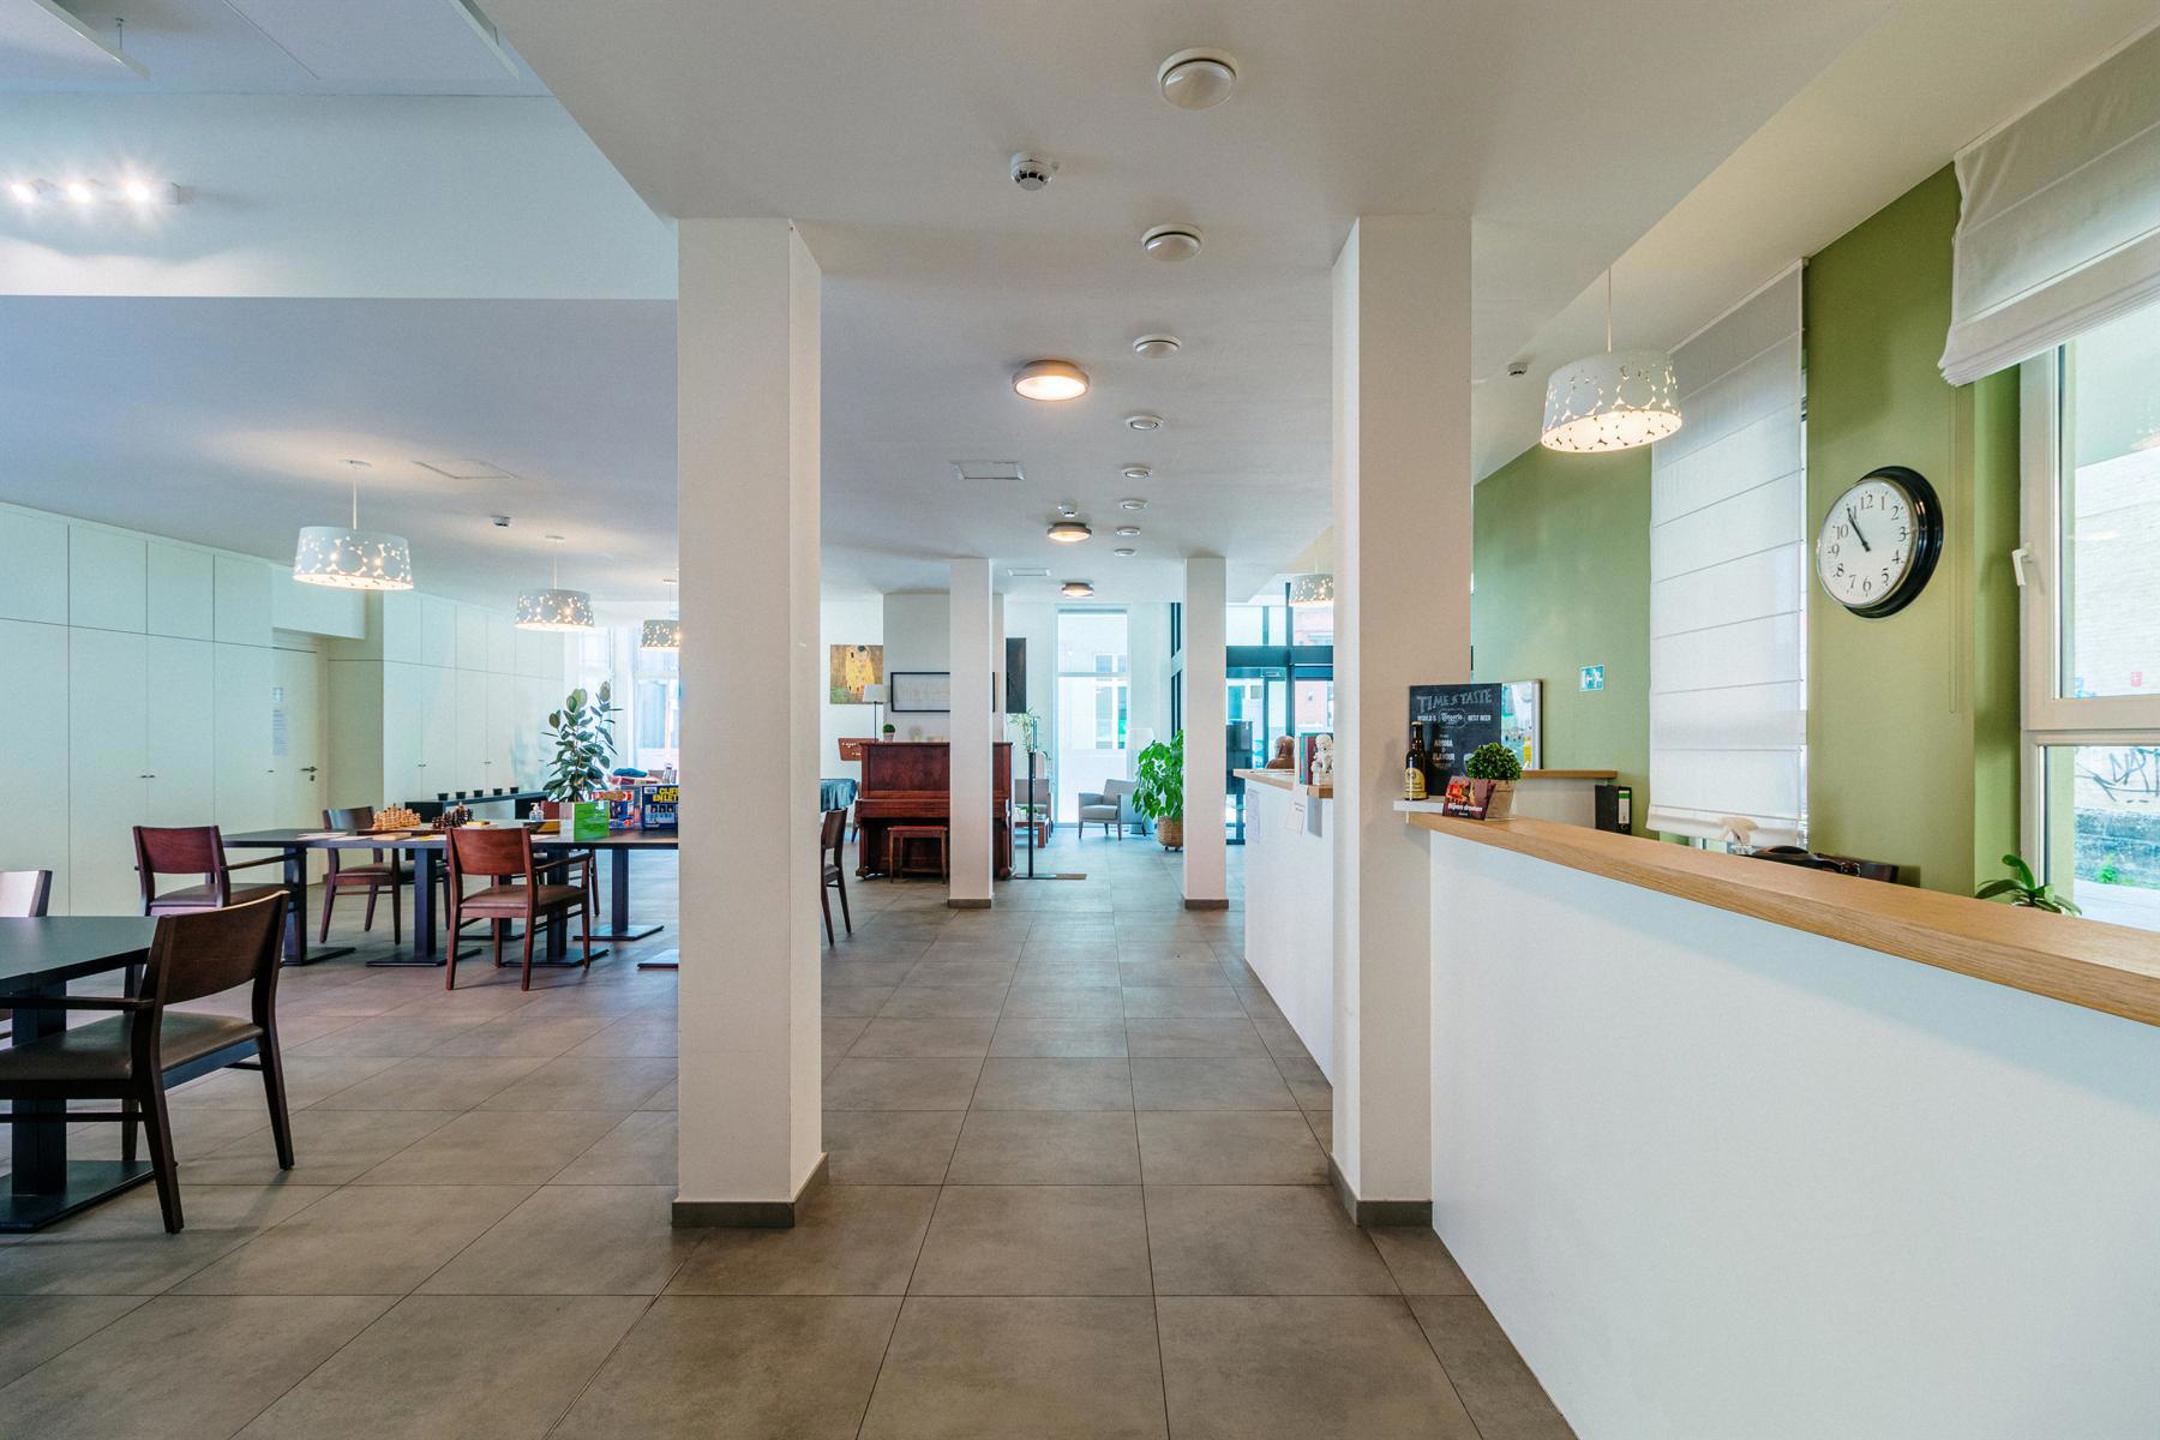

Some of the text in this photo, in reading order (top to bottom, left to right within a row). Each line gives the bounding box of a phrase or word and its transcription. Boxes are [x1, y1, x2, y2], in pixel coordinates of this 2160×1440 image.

[1860, 494, 1873, 510] 12
[1881, 496, 1885, 510] 1
[1891, 505, 1900, 521] 2
[1836, 524, 1849, 540] 10
[1899, 526, 1907, 542] 3
[1831, 544, 1840, 559] 9
[1892, 549, 1900, 564] 4
[1836, 563, 1844, 578] 8
[1881, 568, 1890, 584] 5
[1849, 574, 1857, 589] 7
[1862, 576, 1872, 592] 6
[1416, 695, 1449, 713] TIME
[1460, 689, 1493, 704] TASTE
